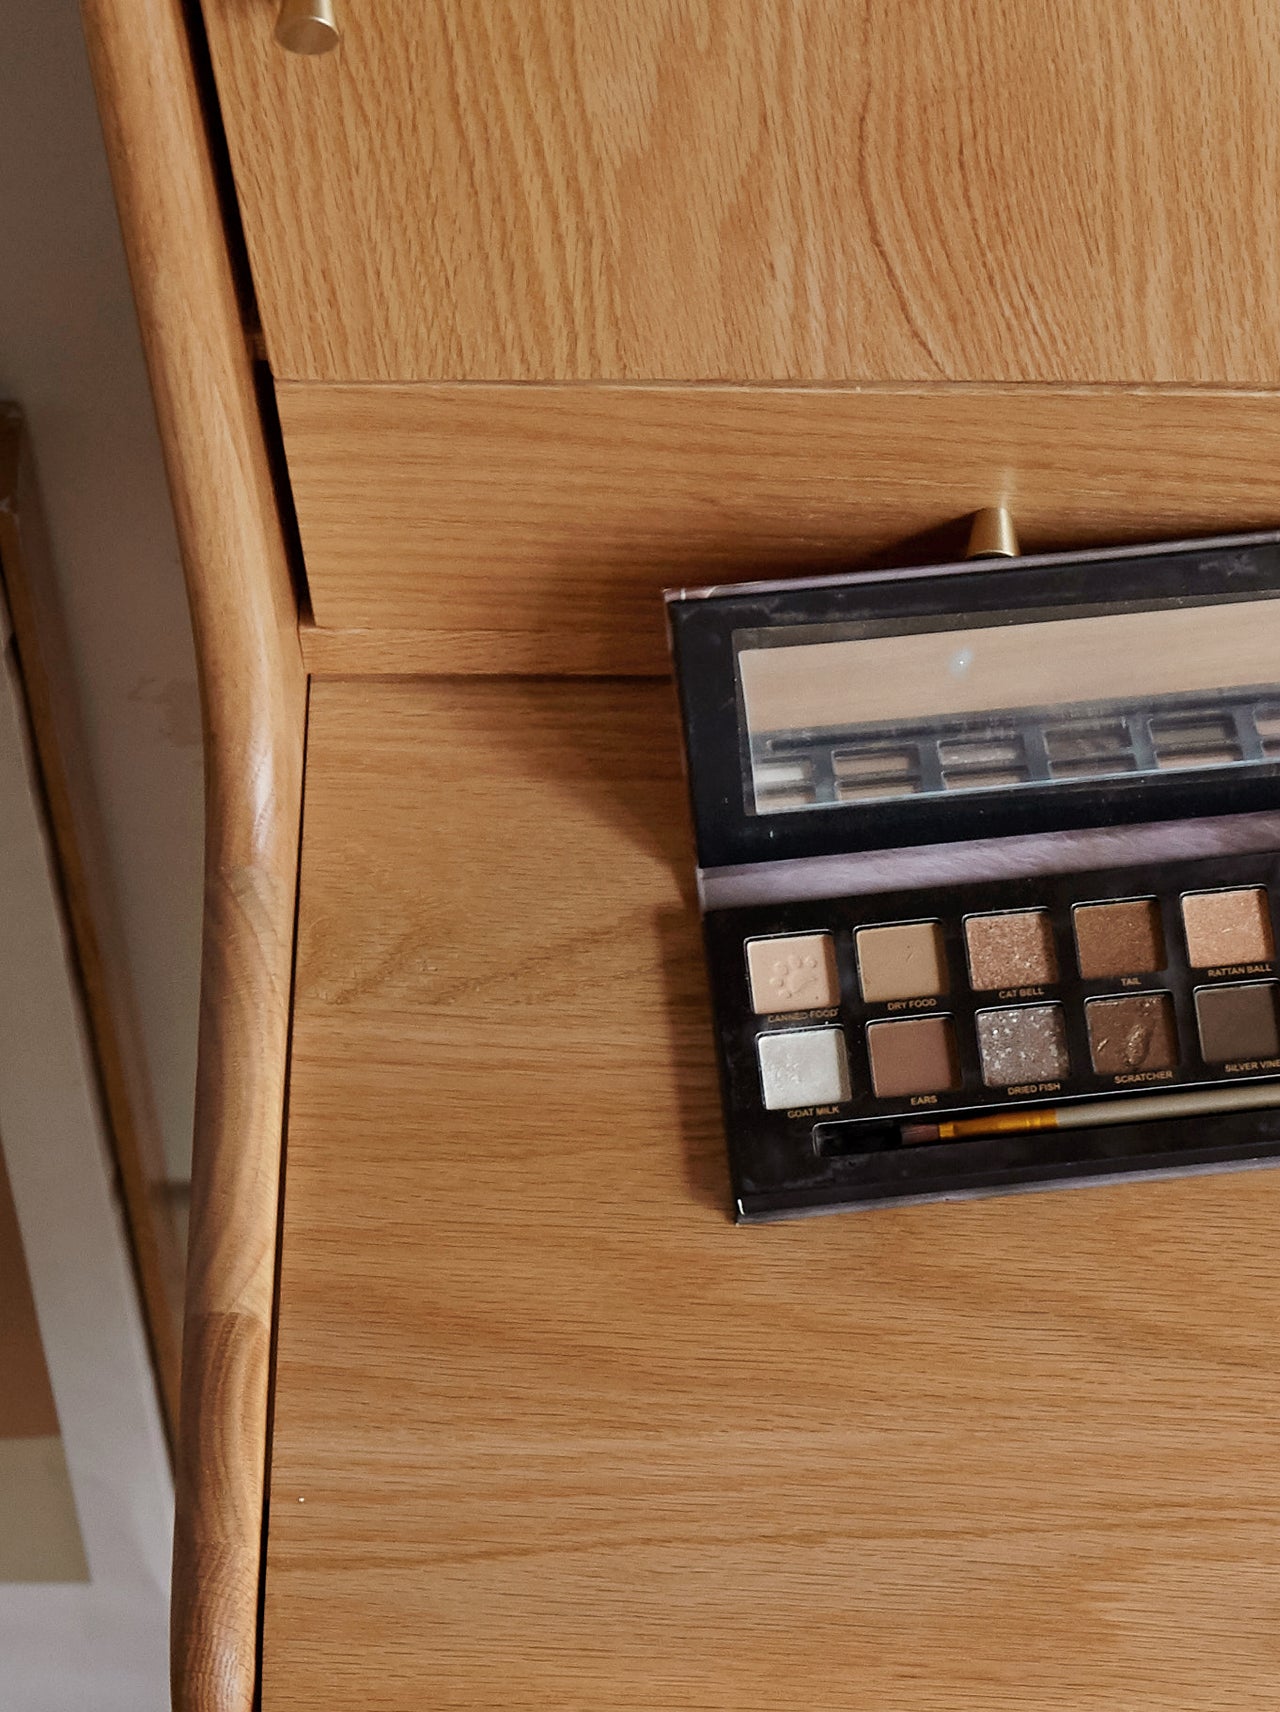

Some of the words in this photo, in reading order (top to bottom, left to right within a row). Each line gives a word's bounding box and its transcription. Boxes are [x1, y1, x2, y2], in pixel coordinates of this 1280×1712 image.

[1207, 965, 1246, 978] RATTAN
[1247, 963, 1273, 975] BALL
[1120, 976, 1142, 988] TAIL
[999, 989, 1018, 1000] CAT
[1019, 987, 1045, 998] BELL
[886, 1001, 907, 1011] DRY
[908, 998, 937, 1009] FOOD
[809, 1008, 839, 1020] FOOD
[1224, 1061, 1259, 1074] SILVER
[1113, 1070, 1174, 1085] SCRATCHER
[1007, 1085, 1038, 1097] DRIED
[1038, 1082, 1062, 1094] FISH
[910, 1095, 938, 1107] EARS
[787, 1108, 814, 1120] GOAT
[816, 1106, 841, 1117] MILK
